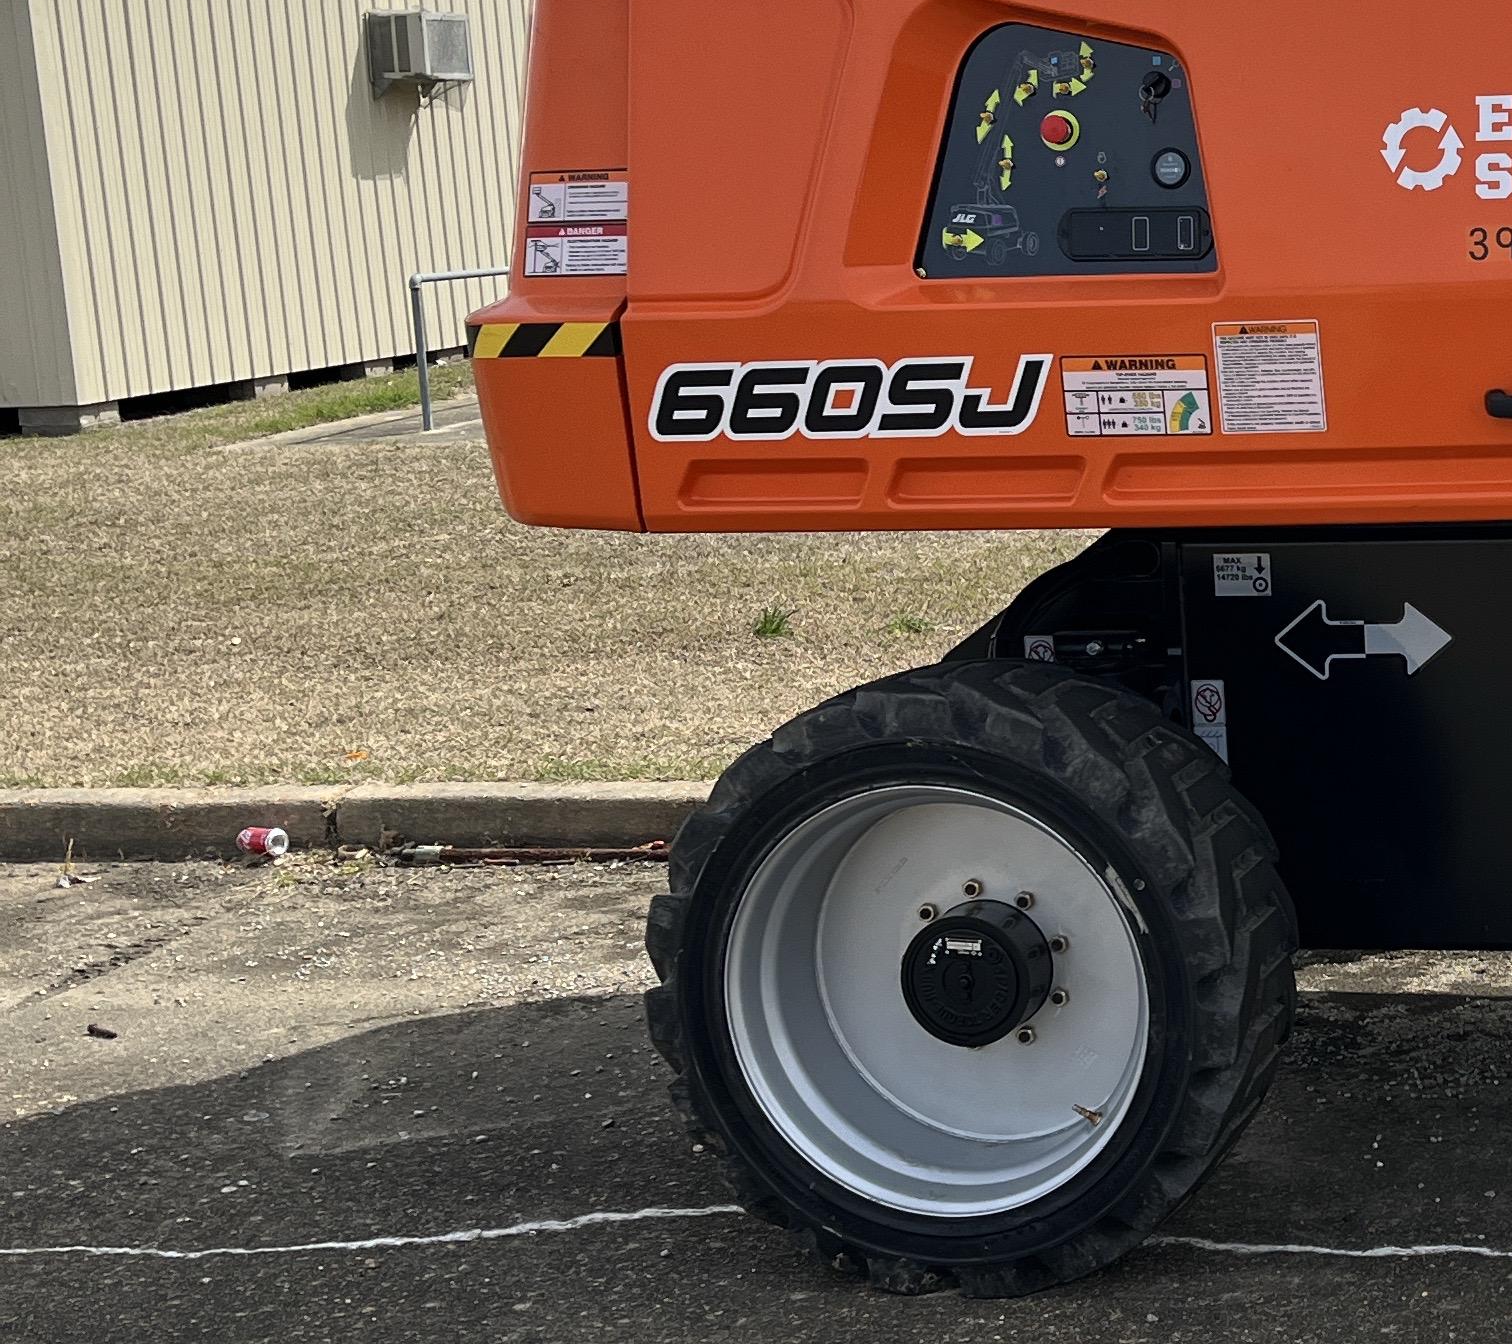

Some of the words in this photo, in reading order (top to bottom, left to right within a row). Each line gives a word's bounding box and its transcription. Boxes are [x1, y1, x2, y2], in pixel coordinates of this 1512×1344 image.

[952, 213, 977, 224] JLG
[565, 227, 605, 235] DANGER
[1105, 359, 1177, 371] WARNING
[650, 355, 1052, 440] 660SJ
